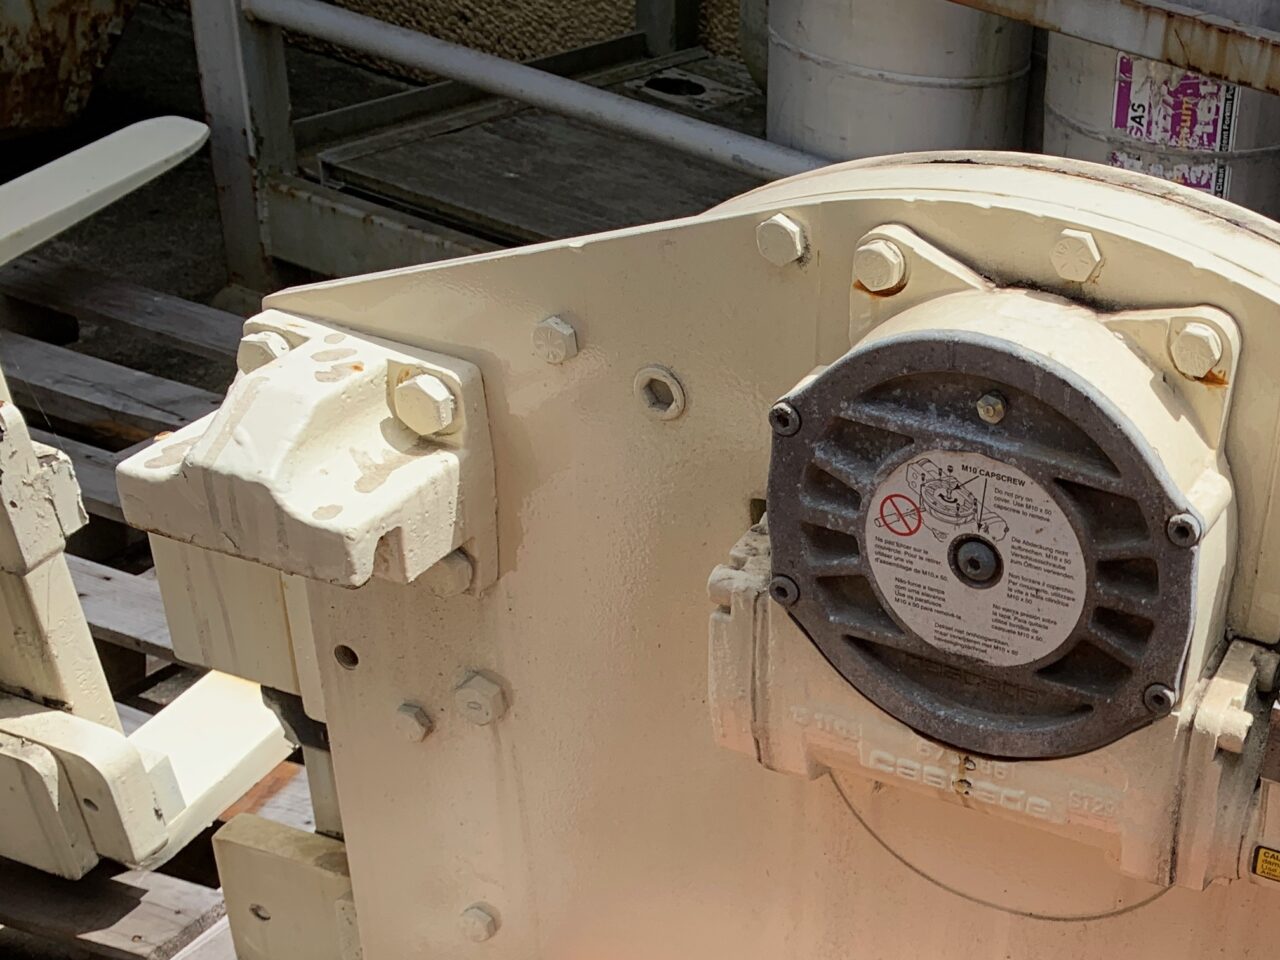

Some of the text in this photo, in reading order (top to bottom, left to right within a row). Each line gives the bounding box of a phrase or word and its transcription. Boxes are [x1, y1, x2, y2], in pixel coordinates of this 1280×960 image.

[961, 464, 1025, 486] M10 CAPSCREW
[1261, 864, 1276, 872] Use
